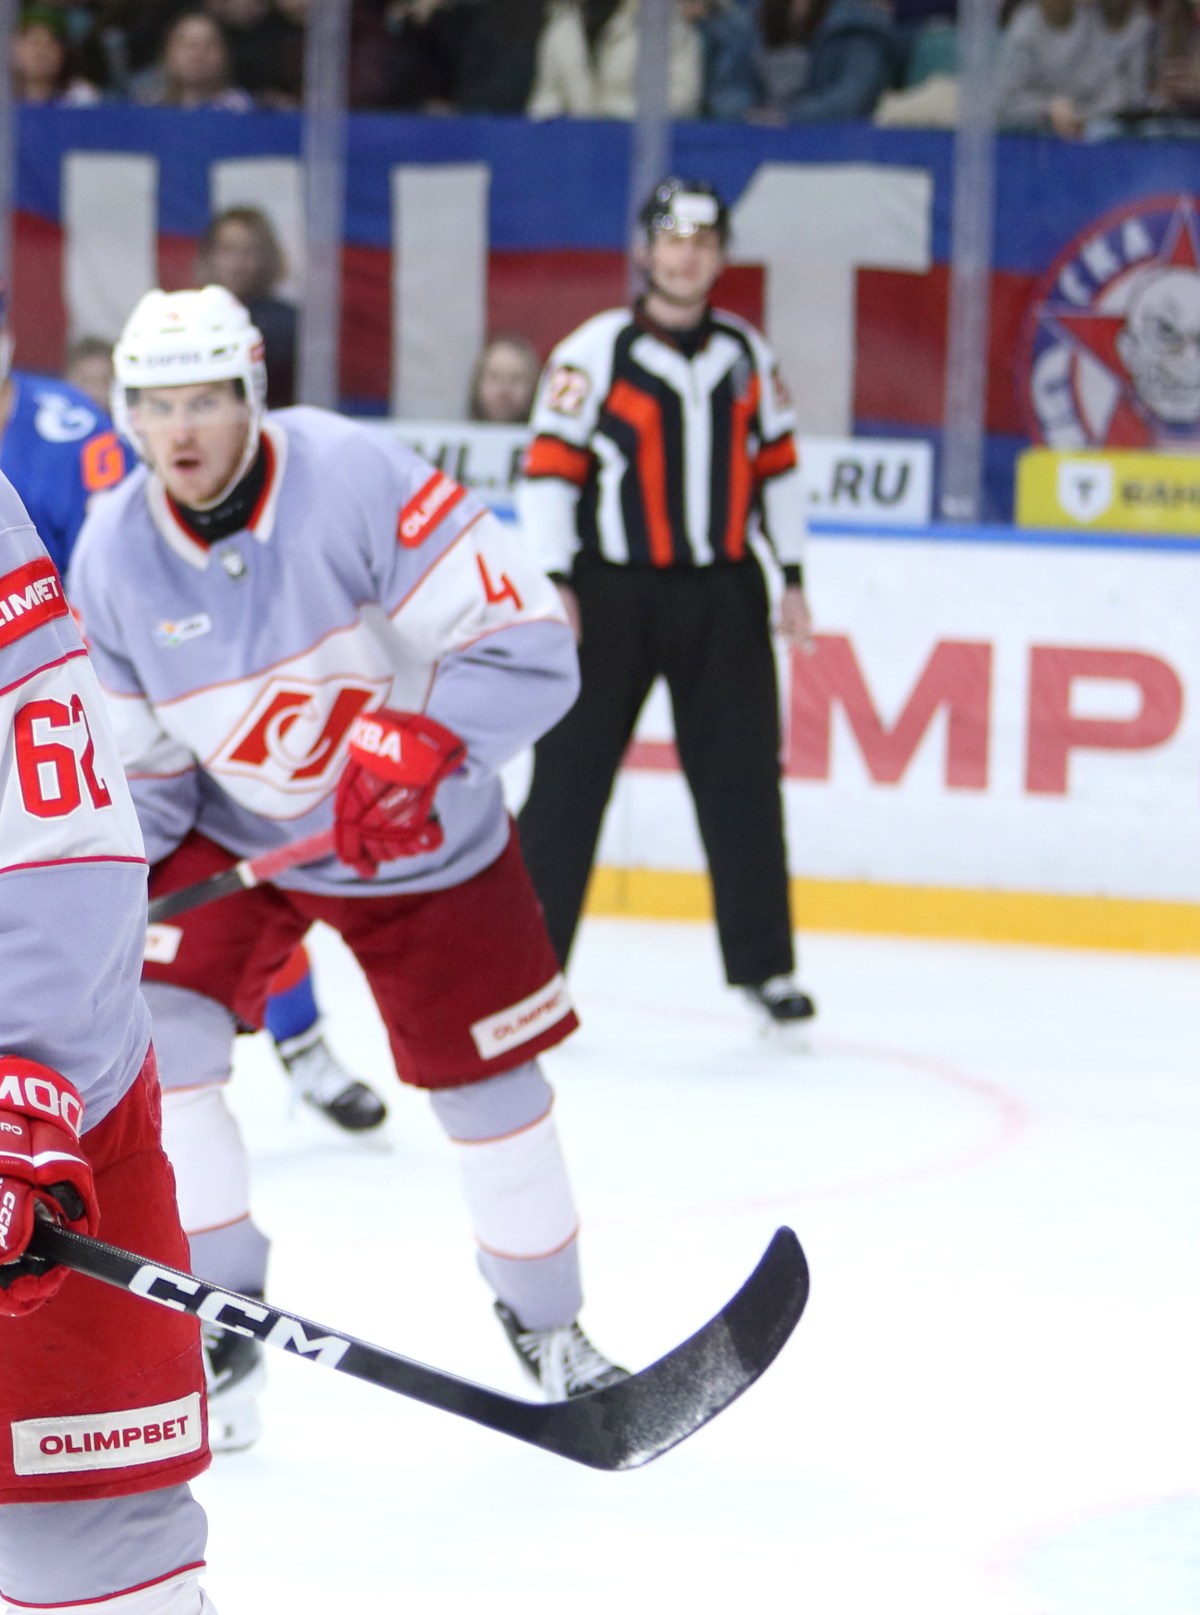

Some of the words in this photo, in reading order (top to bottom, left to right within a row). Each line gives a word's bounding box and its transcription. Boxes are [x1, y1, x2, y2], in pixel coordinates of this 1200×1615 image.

[475, 552, 524, 611] 4
[14, 693, 113, 818] 62
[128, 1264, 352, 1370] CCM
[39, 1415, 189, 1456] OLIMPBET
